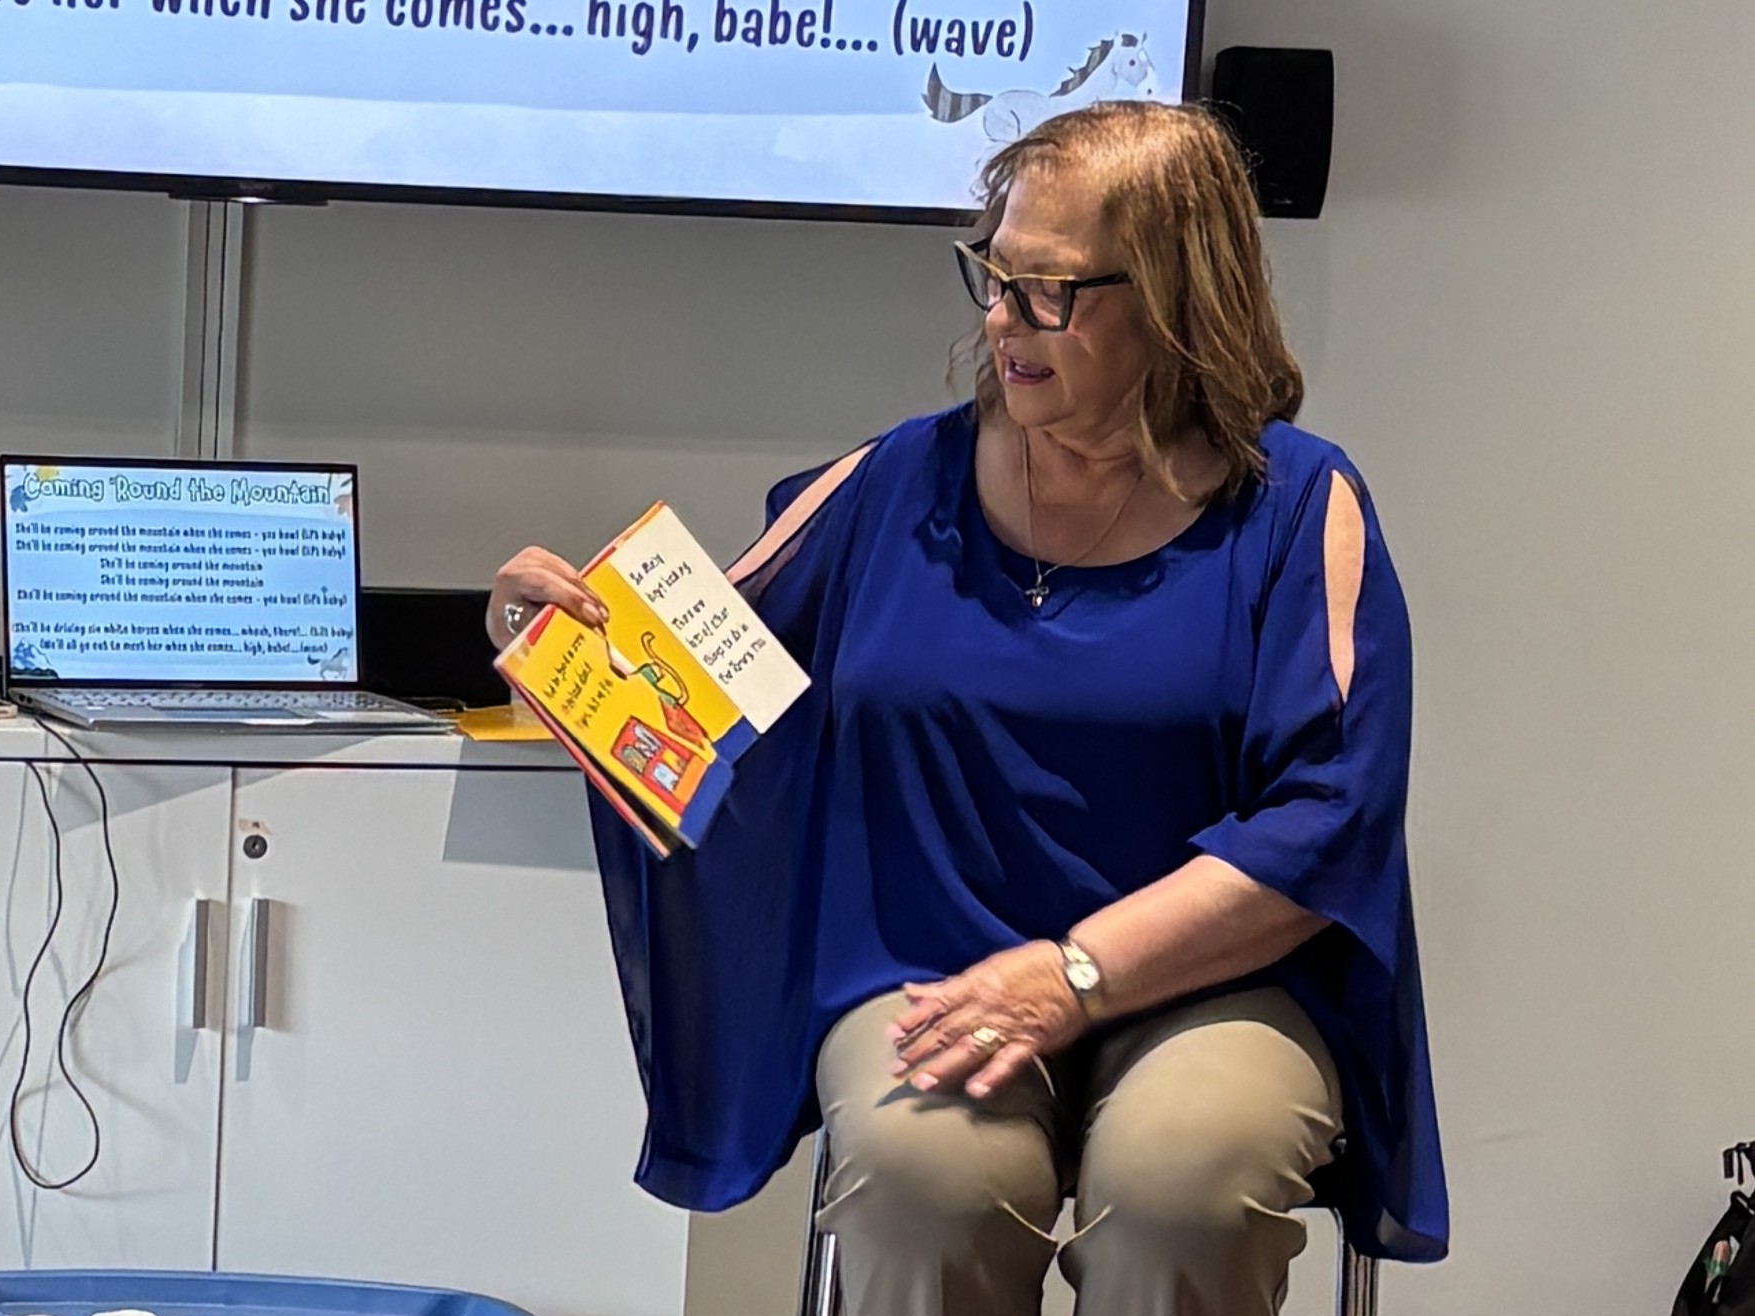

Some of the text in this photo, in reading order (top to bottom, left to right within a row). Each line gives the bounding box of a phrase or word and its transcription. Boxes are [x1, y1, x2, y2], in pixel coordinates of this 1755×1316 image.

[587, 0, 699, 55] high,
[714, 0, 878, 51] babe!...
[894, 0, 1033, 61] (wave)
[23, 472, 104, 502] Coming
[188, 477, 225, 502] the
[231, 478, 331, 506] Mountain
[54, 525, 85, 540] coming
[89, 526, 118, 536] around
[121, 526, 136, 536] the
[139, 526, 180, 537] mountain
[183, 527, 205, 538] when
[208, 527, 222, 538] she
[225, 529, 251, 539] comes
[54, 541, 85, 555] coming
[89, 542, 118, 552] around
[121, 542, 136, 553] the
[139, 543, 180, 554] mountain
[183, 543, 206, 554] when
[208, 544, 223, 555] she
[225, 546, 252, 555] comes
[138, 559, 169, 574] coming
[172, 560, 202, 571] around
[205, 560, 219, 571] the
[222, 561, 262, 571] mountain
[138, 575, 169, 589] coming
[172, 576, 202, 587] around
[205, 576, 219, 587] the
[223, 577, 263, 588] mountain
[56, 590, 86, 605] coming
[89, 591, 120, 602] around
[124, 591, 138, 602] the
[141, 592, 182, 603] mountain
[185, 592, 206, 603] when
[210, 592, 224, 603] she
[226, 595, 252, 604] comes
[163, 624, 184, 635] when
[187, 624, 202, 636] she
[147, 639, 162, 651] her
[165, 641, 187, 652] when
[190, 641, 204, 652] she
